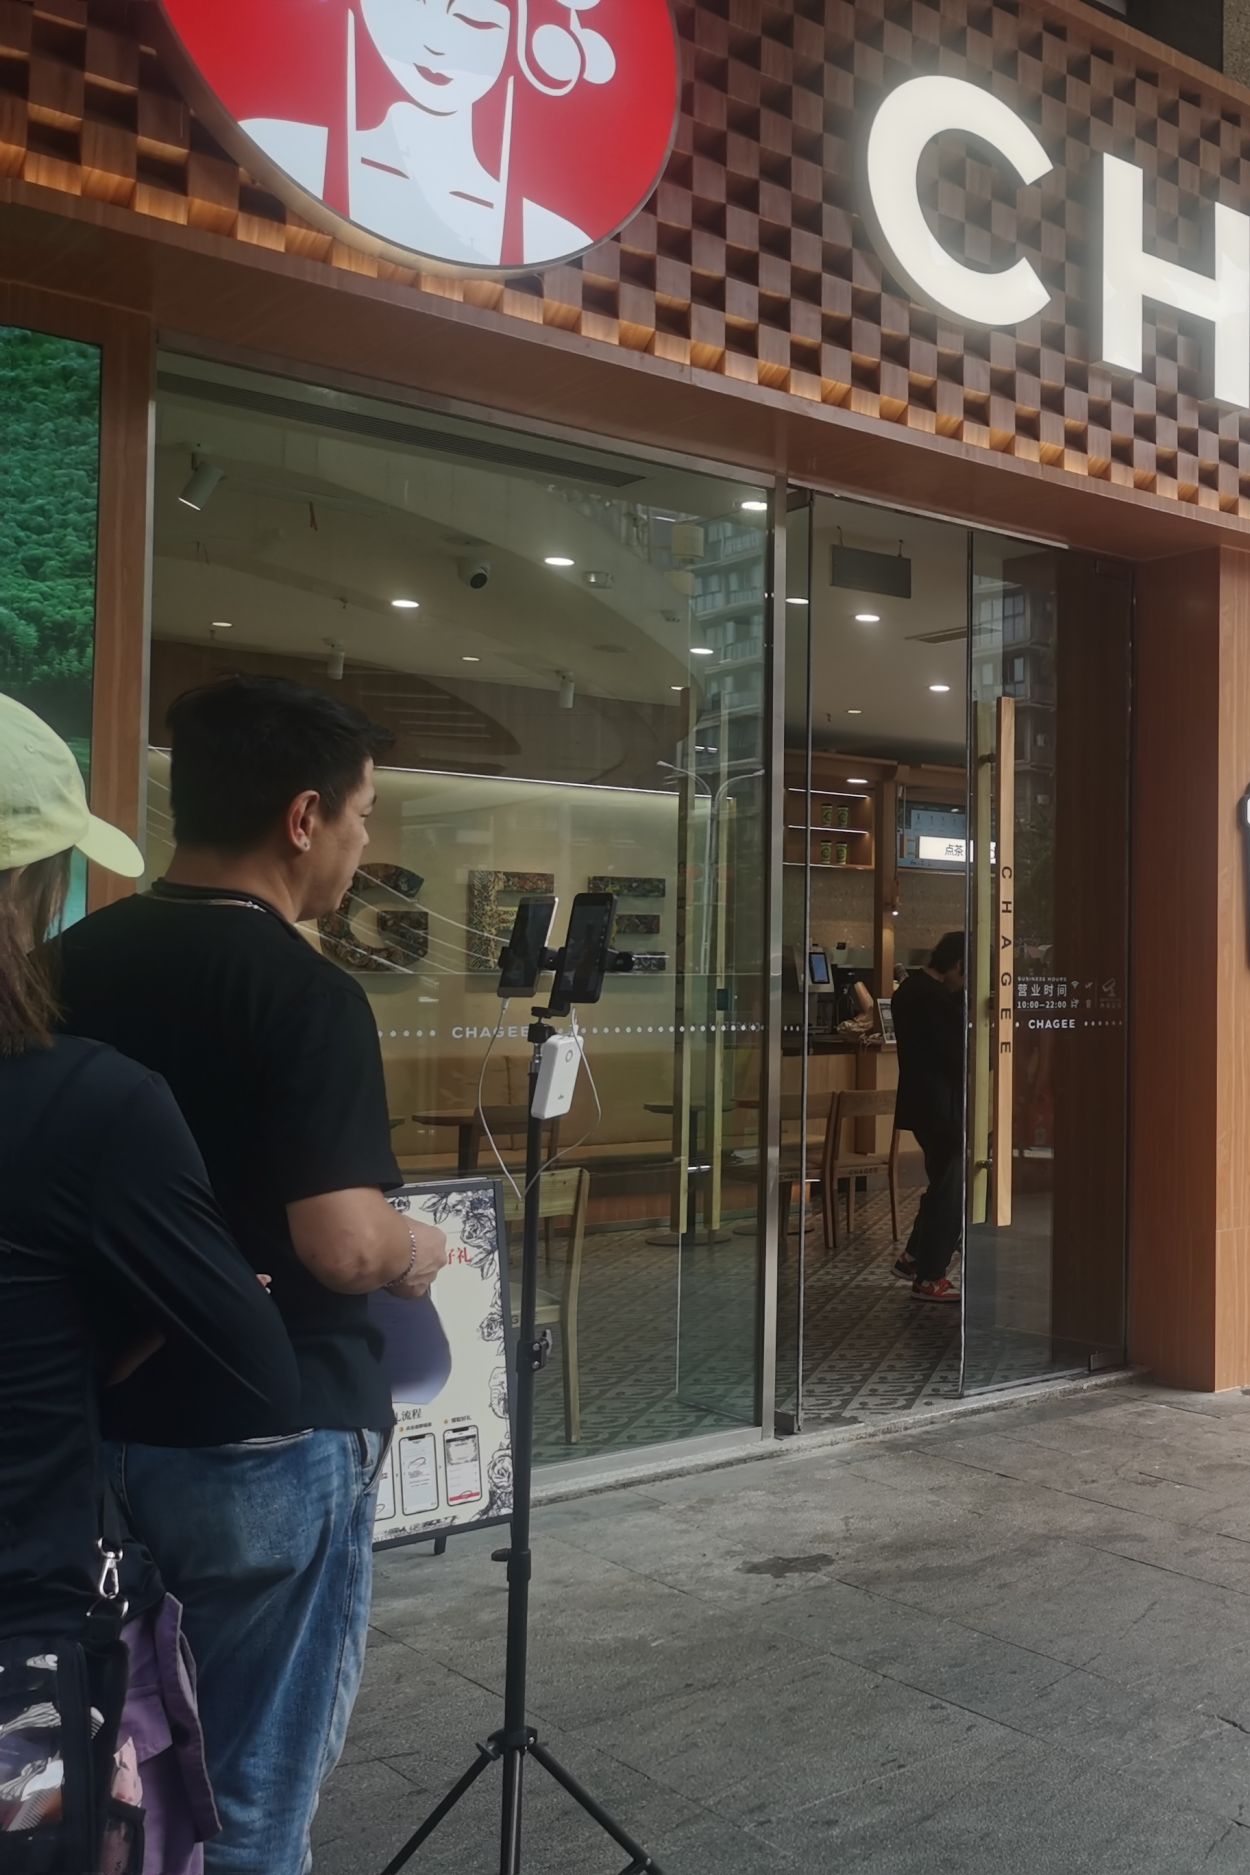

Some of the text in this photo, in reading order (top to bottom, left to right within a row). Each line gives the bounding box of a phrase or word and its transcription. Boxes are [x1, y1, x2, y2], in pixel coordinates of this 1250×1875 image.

[1000, 866, 1012, 1054] CHAGEE
[1018, 983, 1067, 997] 营业时间
[1028, 1019, 1076, 1029] CHAGEE
